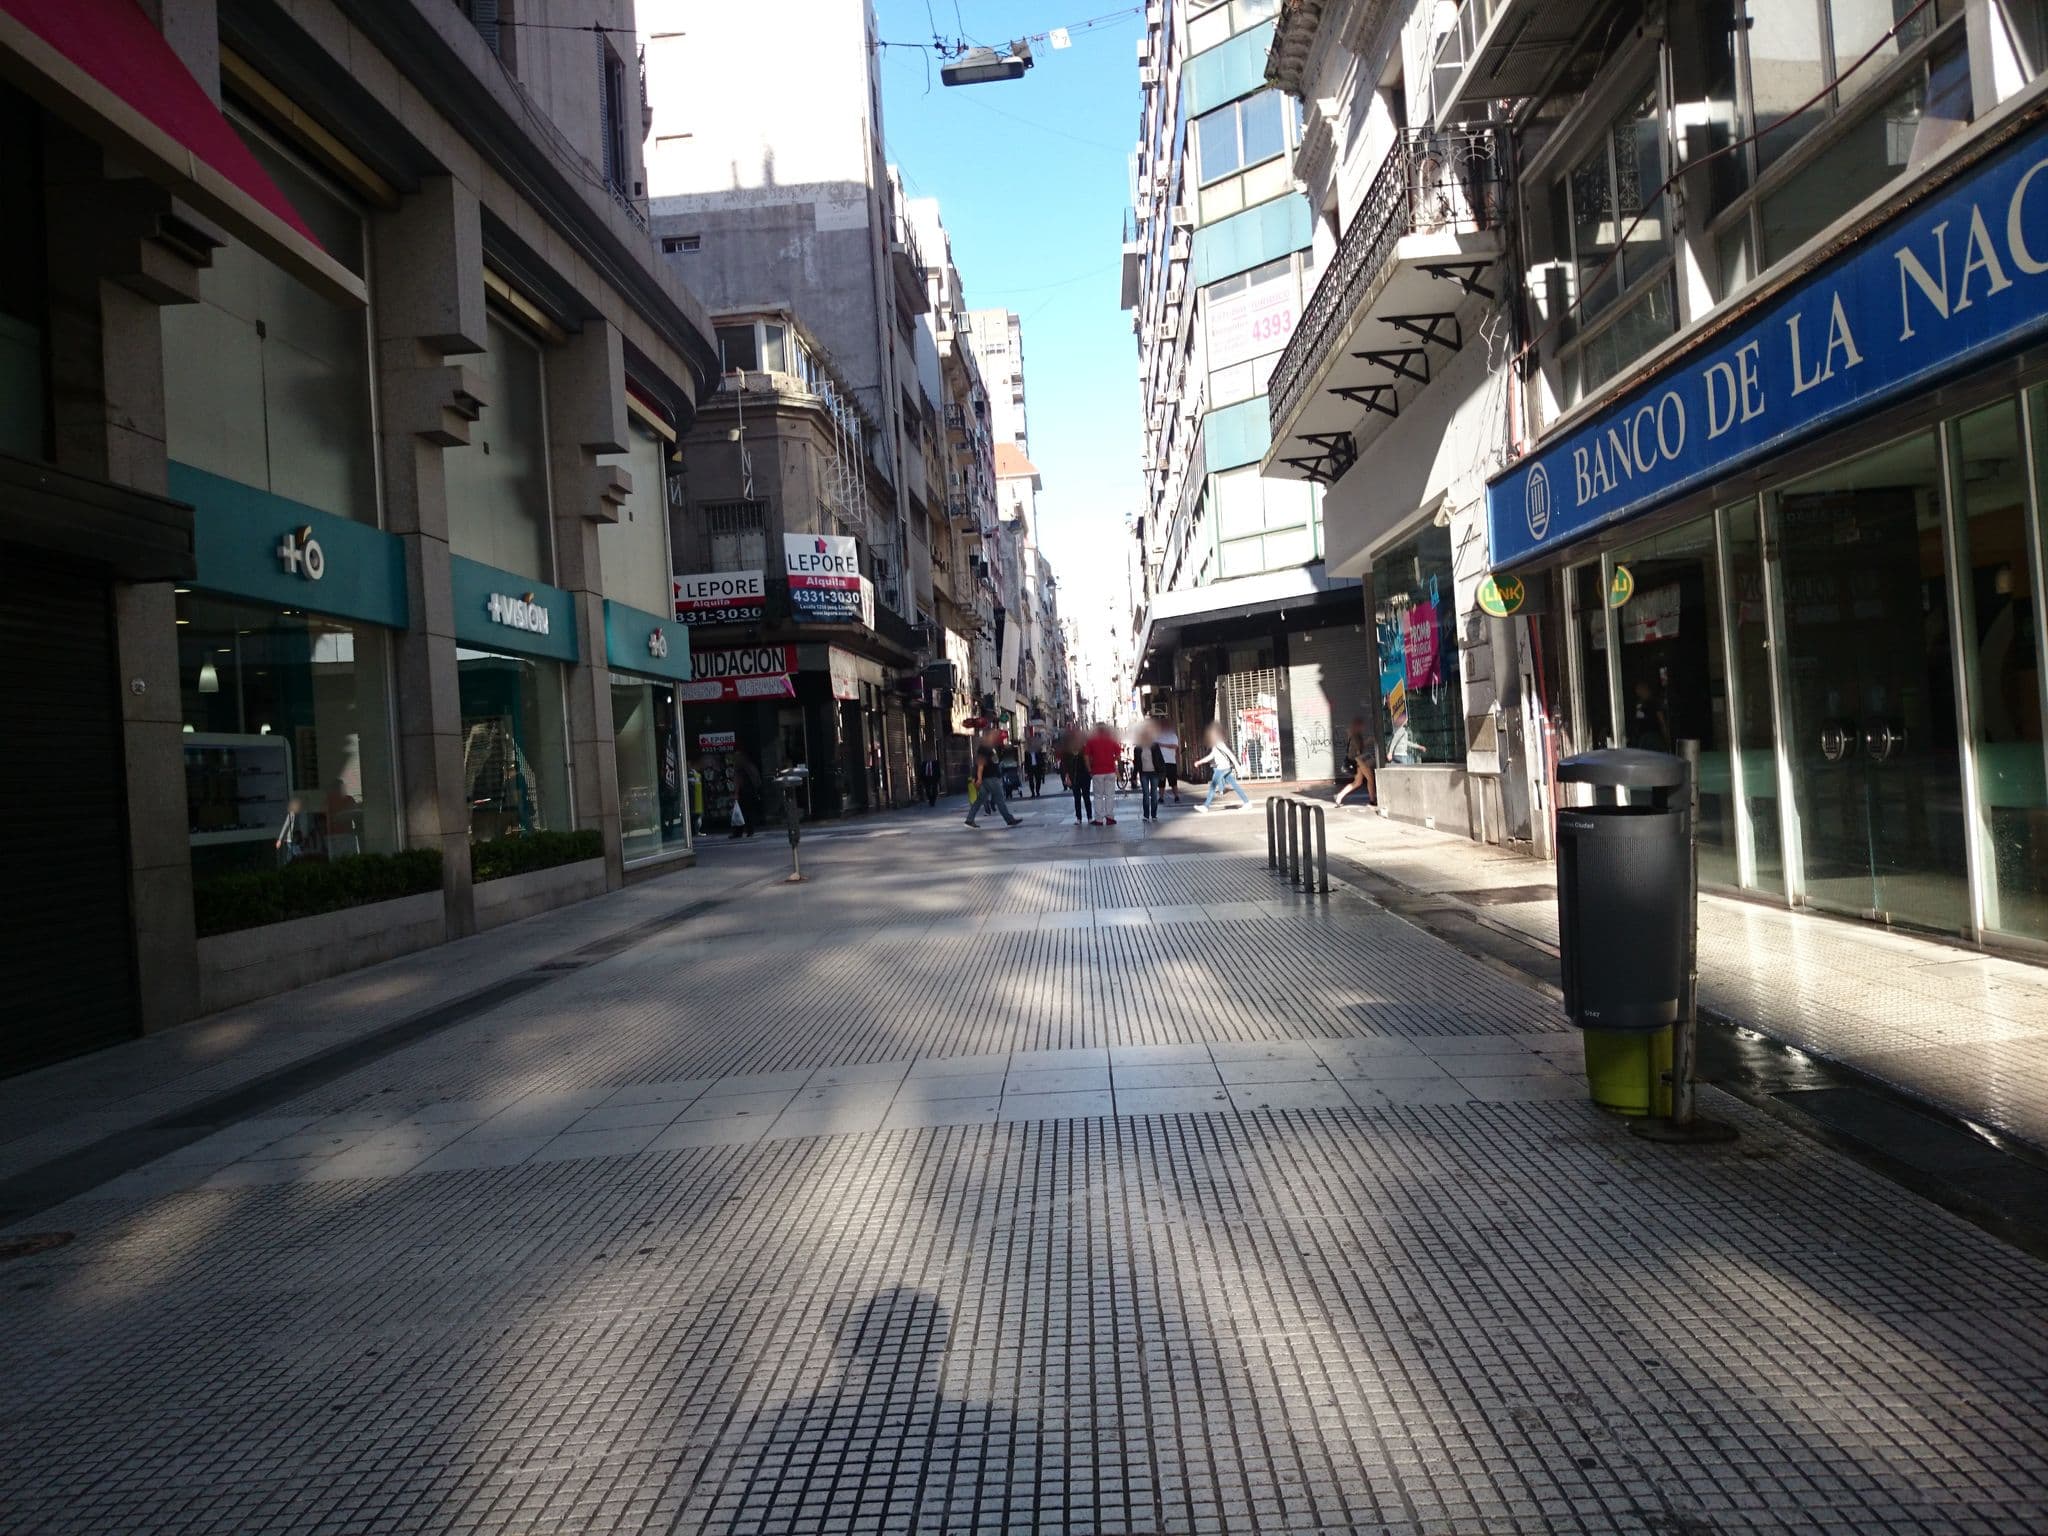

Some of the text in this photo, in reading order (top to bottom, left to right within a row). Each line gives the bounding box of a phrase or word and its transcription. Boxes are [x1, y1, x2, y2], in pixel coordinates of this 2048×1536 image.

[1252, 309, 1292, 341] 4393
[1573, 391, 1686, 507] BANCO
[1703, 340, 1765, 440] DE
[1786, 290, 1863, 397] LA
[788, 553, 856, 573] LEPORE
[687, 578, 759, 598] LEPORE
[806, 577, 845, 587] Alquila
[1484, 582, 1521, 602] LINK
[693, 599, 730, 608] Alquila
[793, 590, 859, 603] 4331-3030
[676, 607, 762, 623] 331-3030
[692, 647, 785, 679] UIDACION
